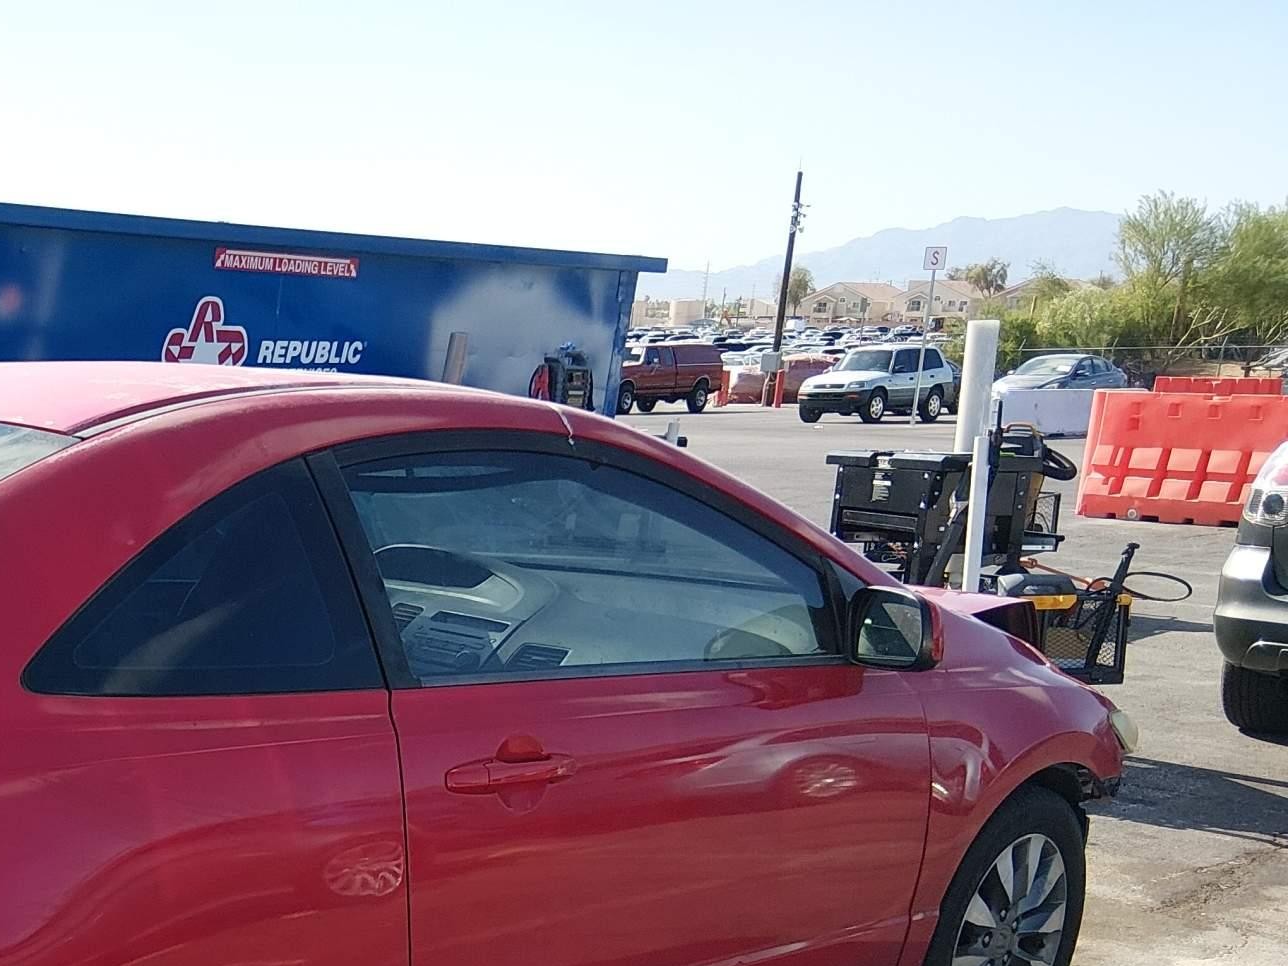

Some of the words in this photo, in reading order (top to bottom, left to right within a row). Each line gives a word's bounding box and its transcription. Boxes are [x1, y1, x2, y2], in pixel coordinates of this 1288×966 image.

[224, 254, 273, 270] MAXIMUM
[275, 257, 319, 274] LOADING
[320, 262, 351, 277] LEVEL
[931, 251, 940, 266] S
[257, 340, 364, 364] REPUBLIC
